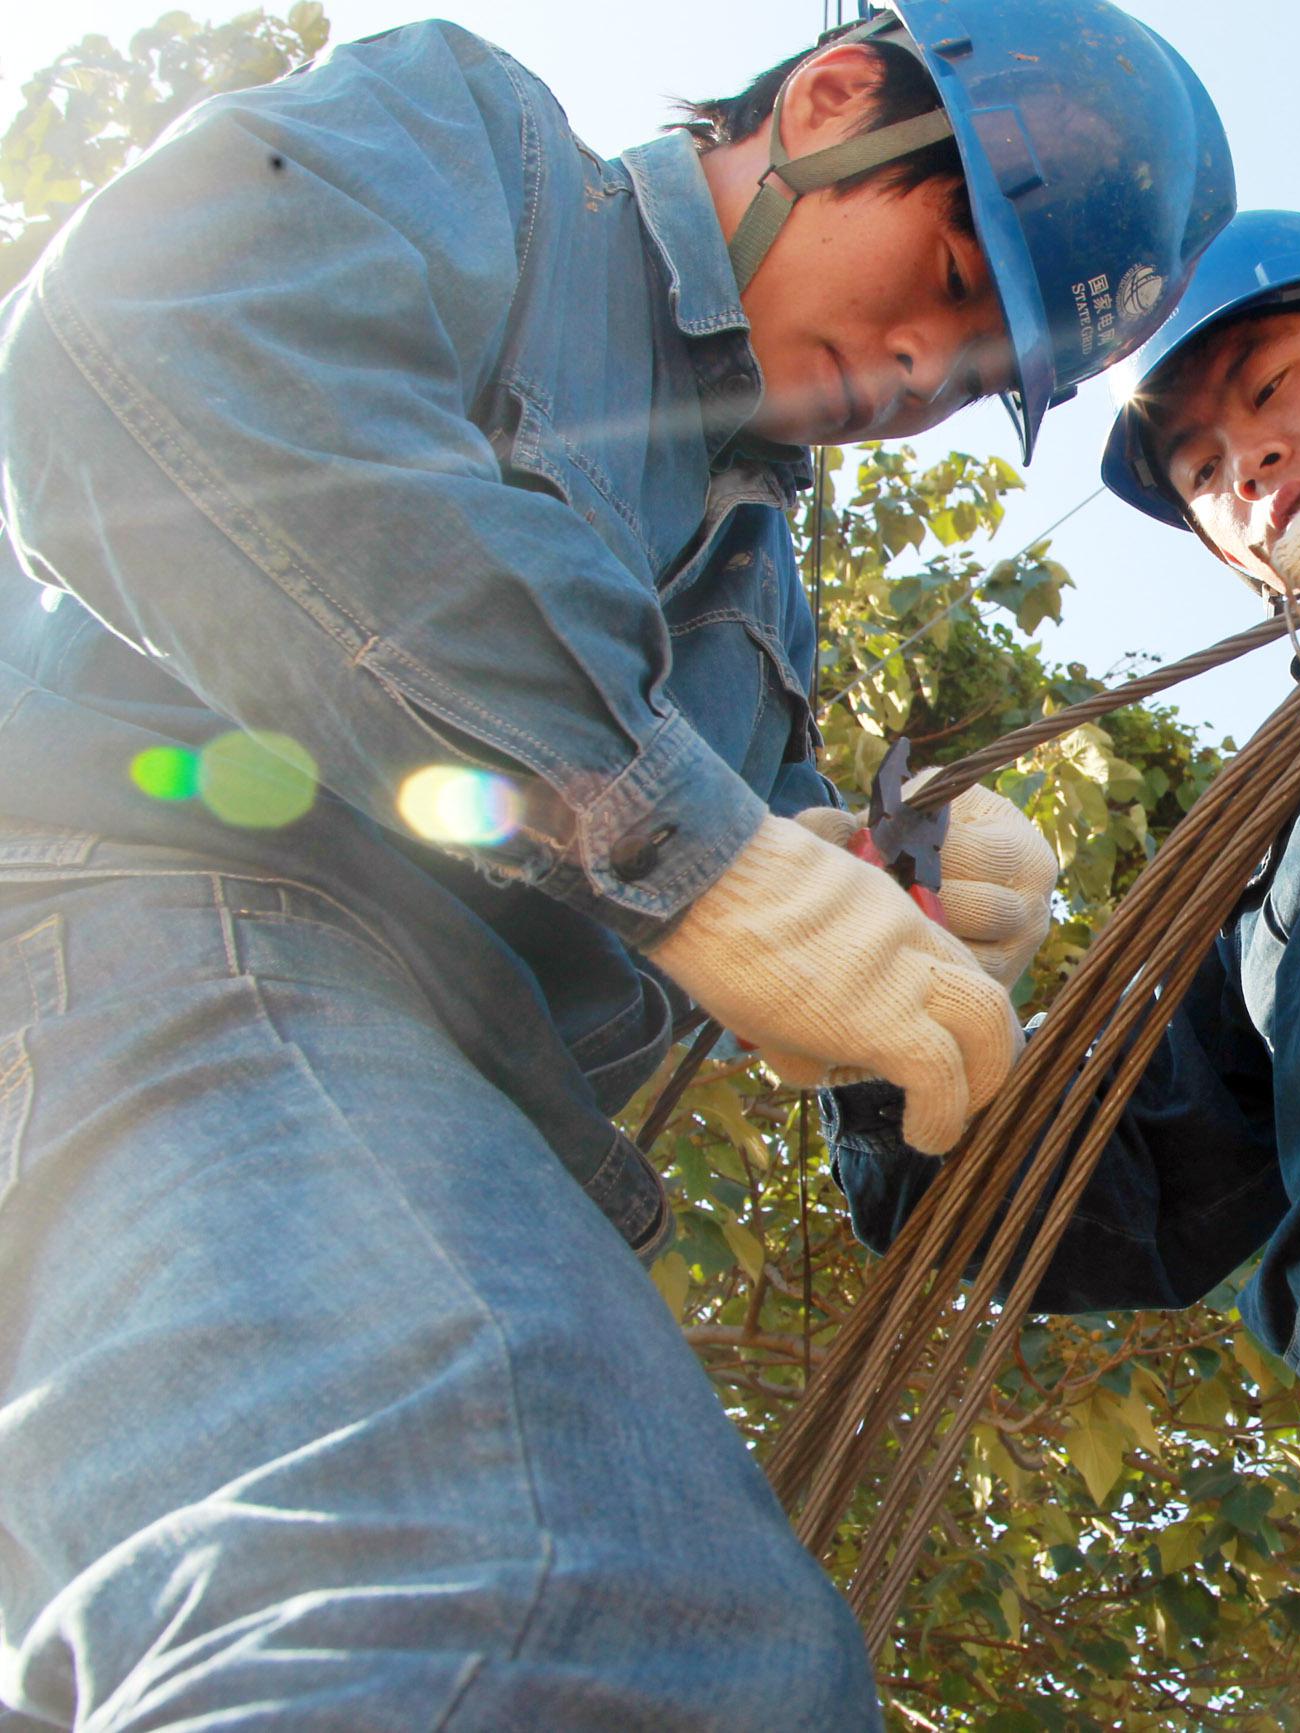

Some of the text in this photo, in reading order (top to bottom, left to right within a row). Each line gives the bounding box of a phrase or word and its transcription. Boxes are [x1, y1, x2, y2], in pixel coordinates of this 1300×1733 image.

[1072, 282, 1094, 355] STATE GRID
[1088, 273, 1115, 346] 国家电网
